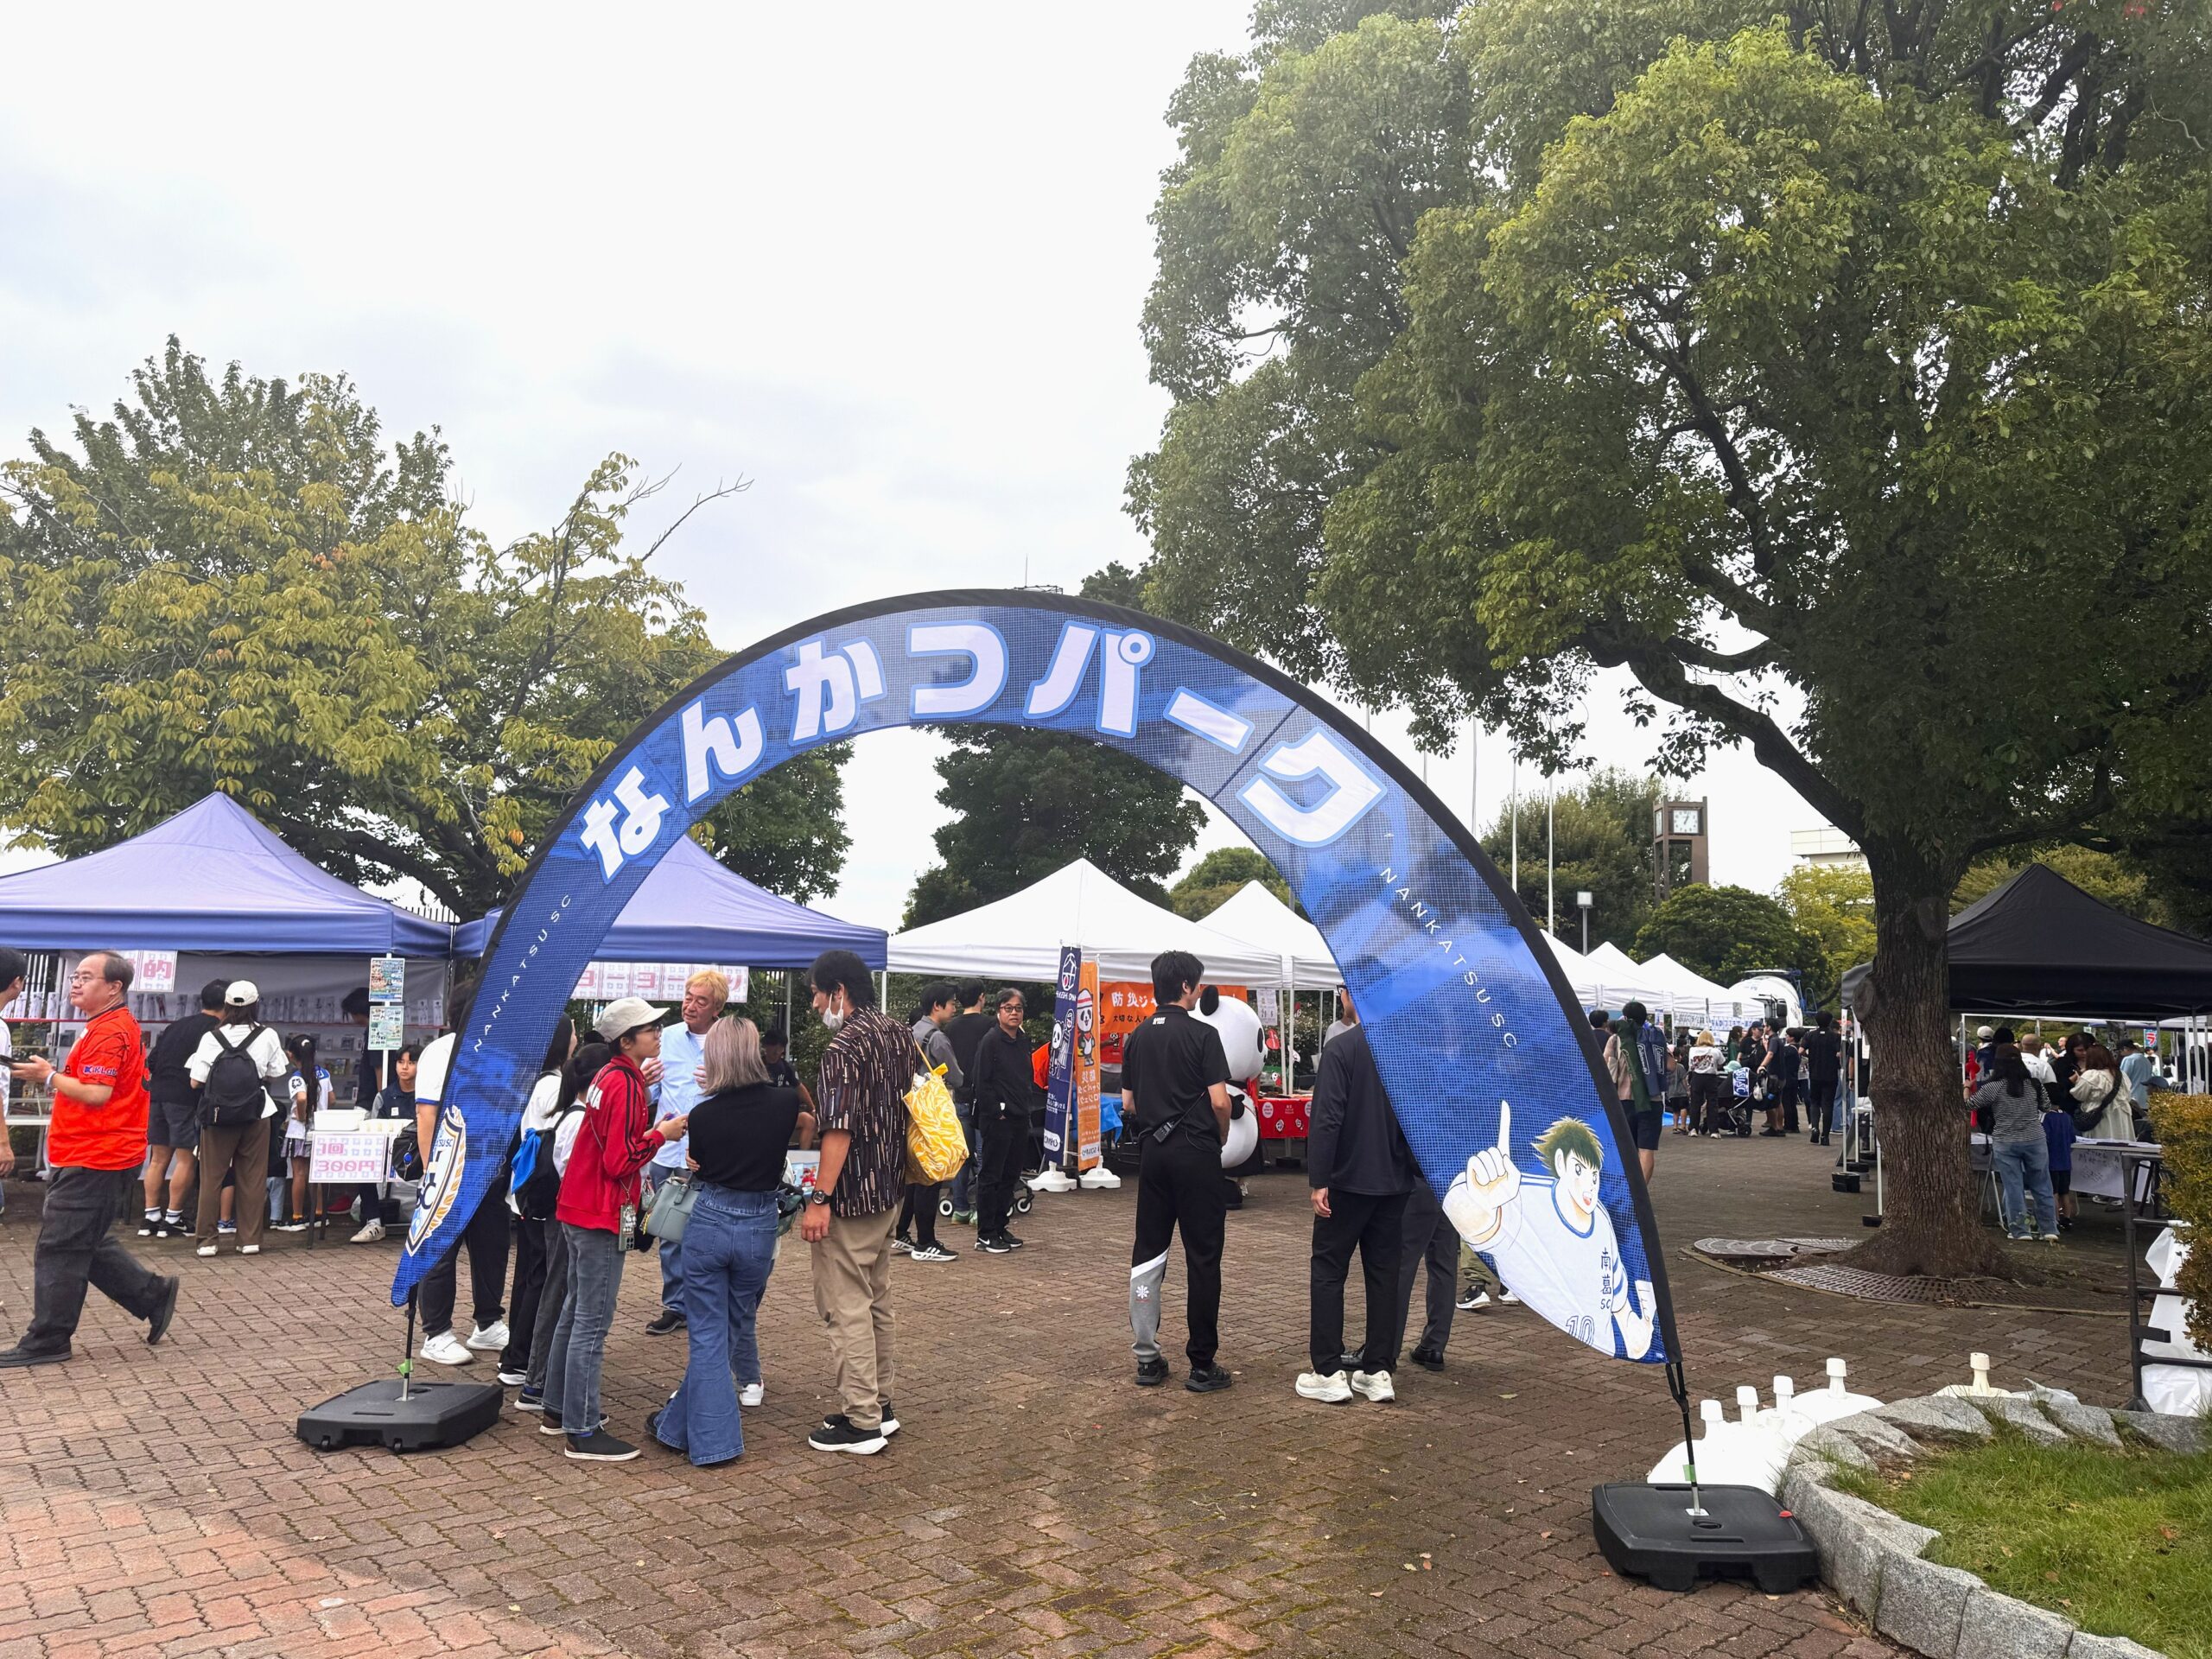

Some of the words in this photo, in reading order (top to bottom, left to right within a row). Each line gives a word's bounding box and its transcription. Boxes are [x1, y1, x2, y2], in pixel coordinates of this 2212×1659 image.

[576, 620, 1388, 882] なんかつパーク
[474, 929, 548, 1052] NANKATSU
[550, 894, 571, 923] SC
[1380, 867, 1491, 1003] NANKATSU
[1491, 1013, 1517, 1048] SC
[1113, 1014, 1147, 1023] 大切な人
[320, 1142, 344, 1154] 1回
[317, 1160, 375, 1173] 300円
[1565, 1315, 1595, 1346] 10
